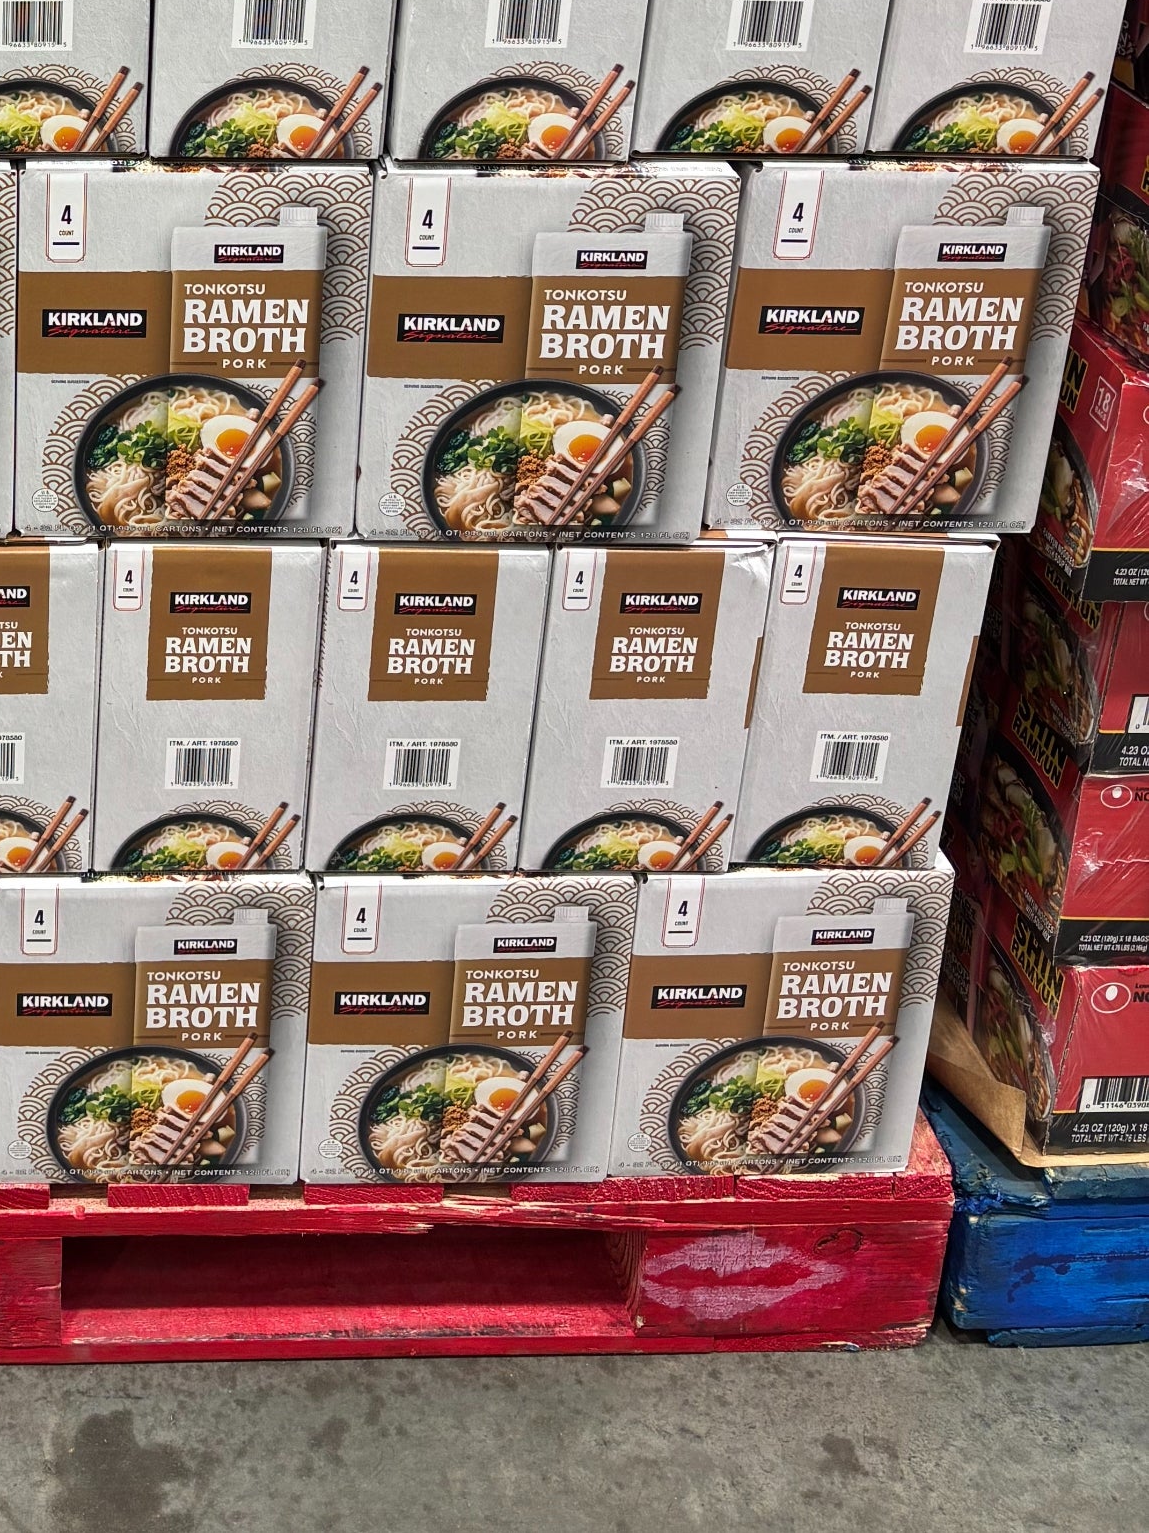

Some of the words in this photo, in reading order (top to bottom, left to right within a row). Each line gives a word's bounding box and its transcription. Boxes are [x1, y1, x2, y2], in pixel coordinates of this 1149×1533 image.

[422, 210, 433, 229] 4
[545, 290, 626, 300] TONKOTSU
[542, 305, 670, 330] RAMEN
[404, 317, 500, 331] KIRKLAND
[539, 334, 665, 359] BROTH
[579, 365, 623, 374] PORK
[1099, 387, 1110, 412] 18
[795, 565, 802, 578] 4
[1115, 568, 1131, 576] 4.23
[843, 590, 916, 601] KIRKLAND
[846, 622, 900, 630] TONKOTSU
[827, 632, 914, 649] RAMEN
[824, 650, 909, 668] BROTH
[1122, 746, 1138, 755] 4.23
[1120, 757, 1140, 766] TOTAL
[356, 908, 366, 923] 4
[1093, 935, 1100, 943] OZ
[1101, 935, 1118, 944] (120g)
[466, 970, 539, 979] TONKOTSU
[464, 981, 578, 1003] RAMEN
[340, 995, 426, 1005] KIRKLAND
[462, 1005, 574, 1026] BROTH
[498, 1031, 537, 1039] PORK
[1073, 1124, 1089, 1132] 4.23
[1092, 1124, 1103, 1132] OZ
[1104, 1124, 1128, 1134] (120g)
[1131, 1124, 1137, 1132] X
[1139, 1124, 1148, 1132] 18
